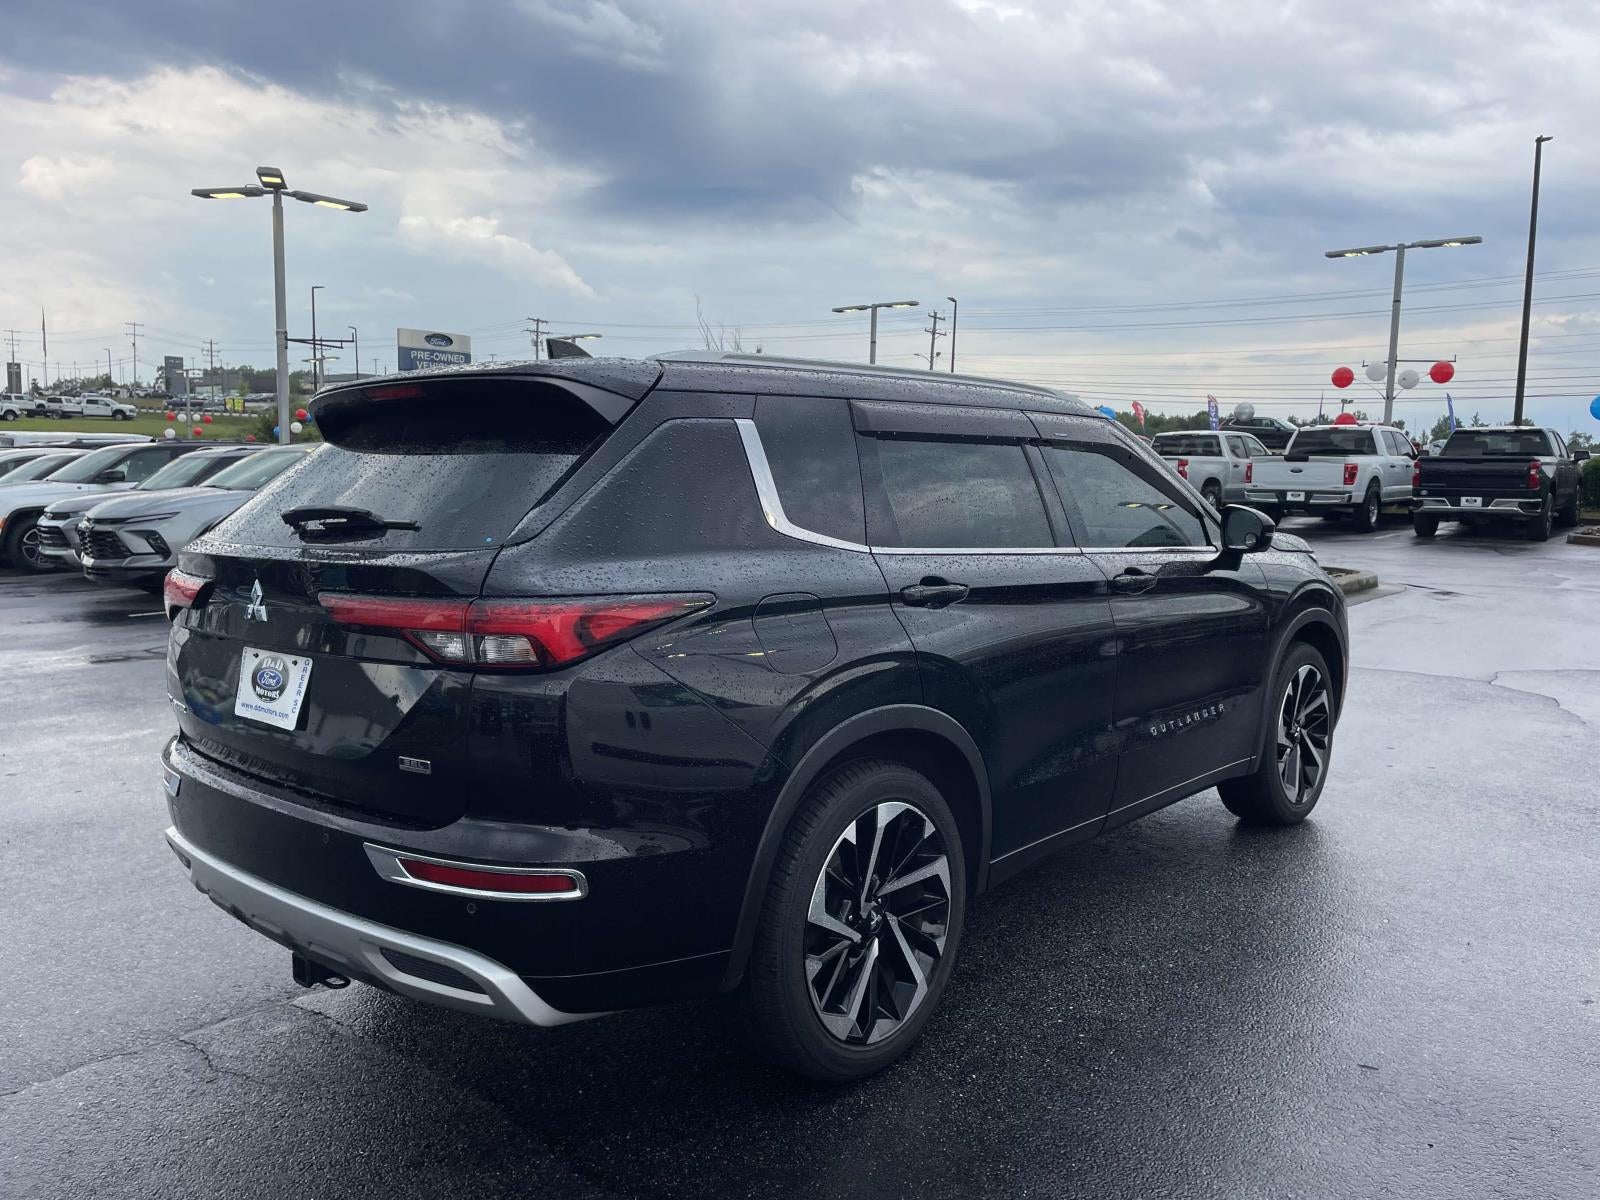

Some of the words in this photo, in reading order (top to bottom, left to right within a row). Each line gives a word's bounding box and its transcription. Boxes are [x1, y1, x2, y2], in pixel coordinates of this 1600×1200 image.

[430, 338, 446, 346] Ford
[411, 351, 465, 363] PRE-OWNED
[261, 671, 278, 686] Ford
[296, 659, 310, 697] GREER
[255, 685, 280, 699] MOTORS
[1150, 703, 1225, 736] OUTLANDER
